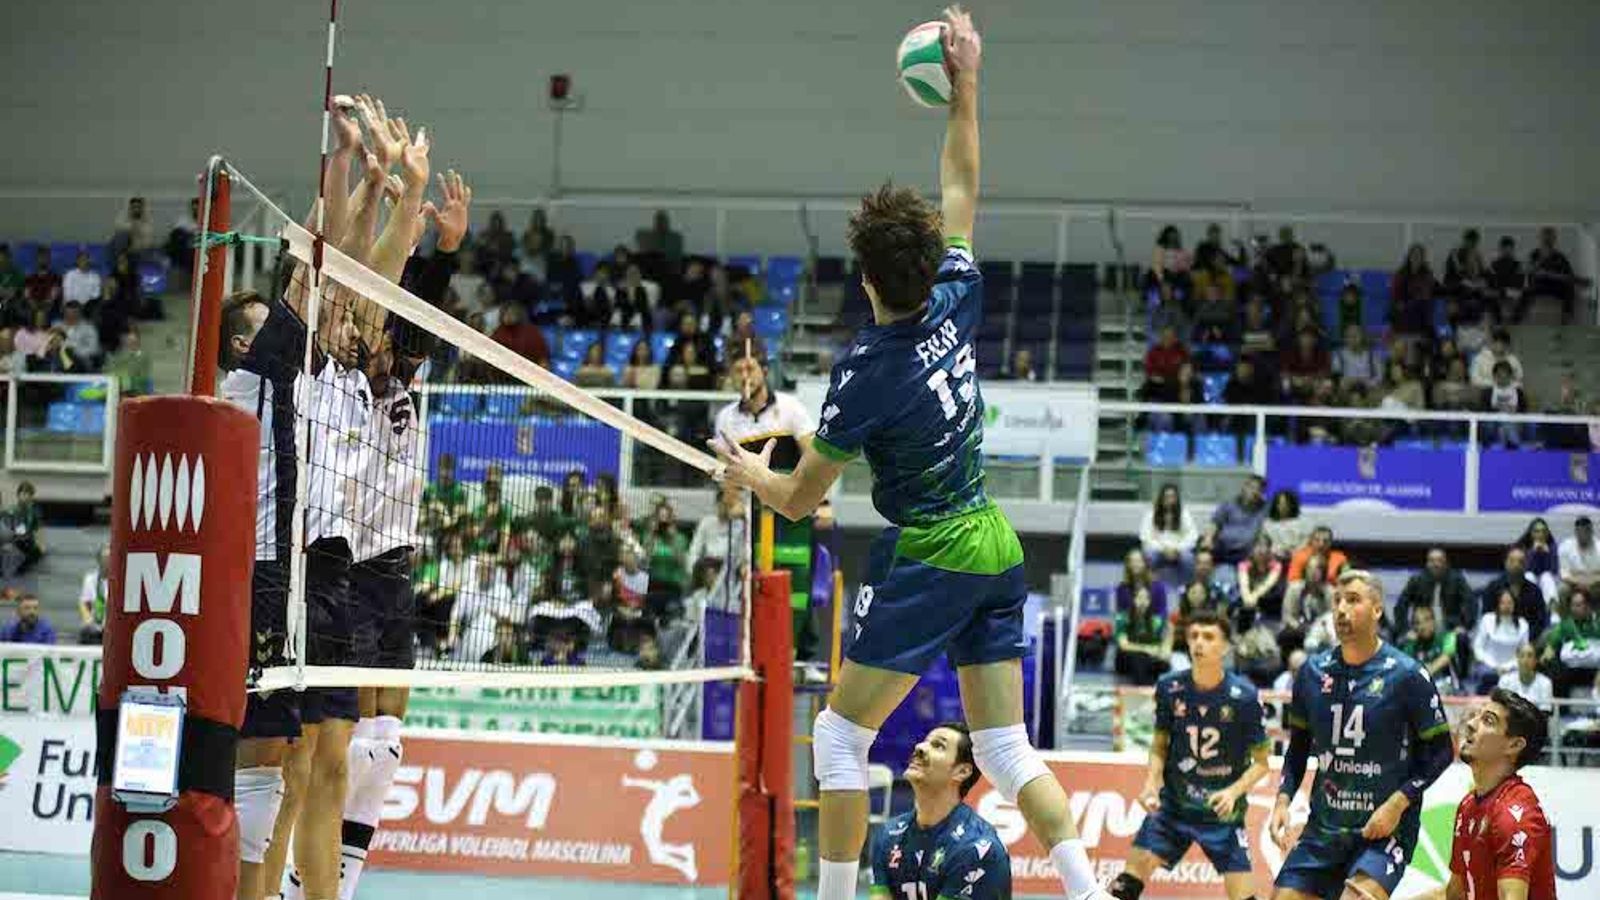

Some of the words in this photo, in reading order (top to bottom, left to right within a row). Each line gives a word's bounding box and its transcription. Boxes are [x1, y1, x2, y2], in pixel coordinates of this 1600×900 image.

[1185, 724, 1221, 760] 12
[1330, 704, 1366, 748] 14
[1333, 758, 1382, 778] Unicaja
[32, 782, 93, 821] Un
[379, 765, 557, 829] SVM
[532, 839, 631, 865] MASCULINA
[1551, 826, 1593, 881] U
